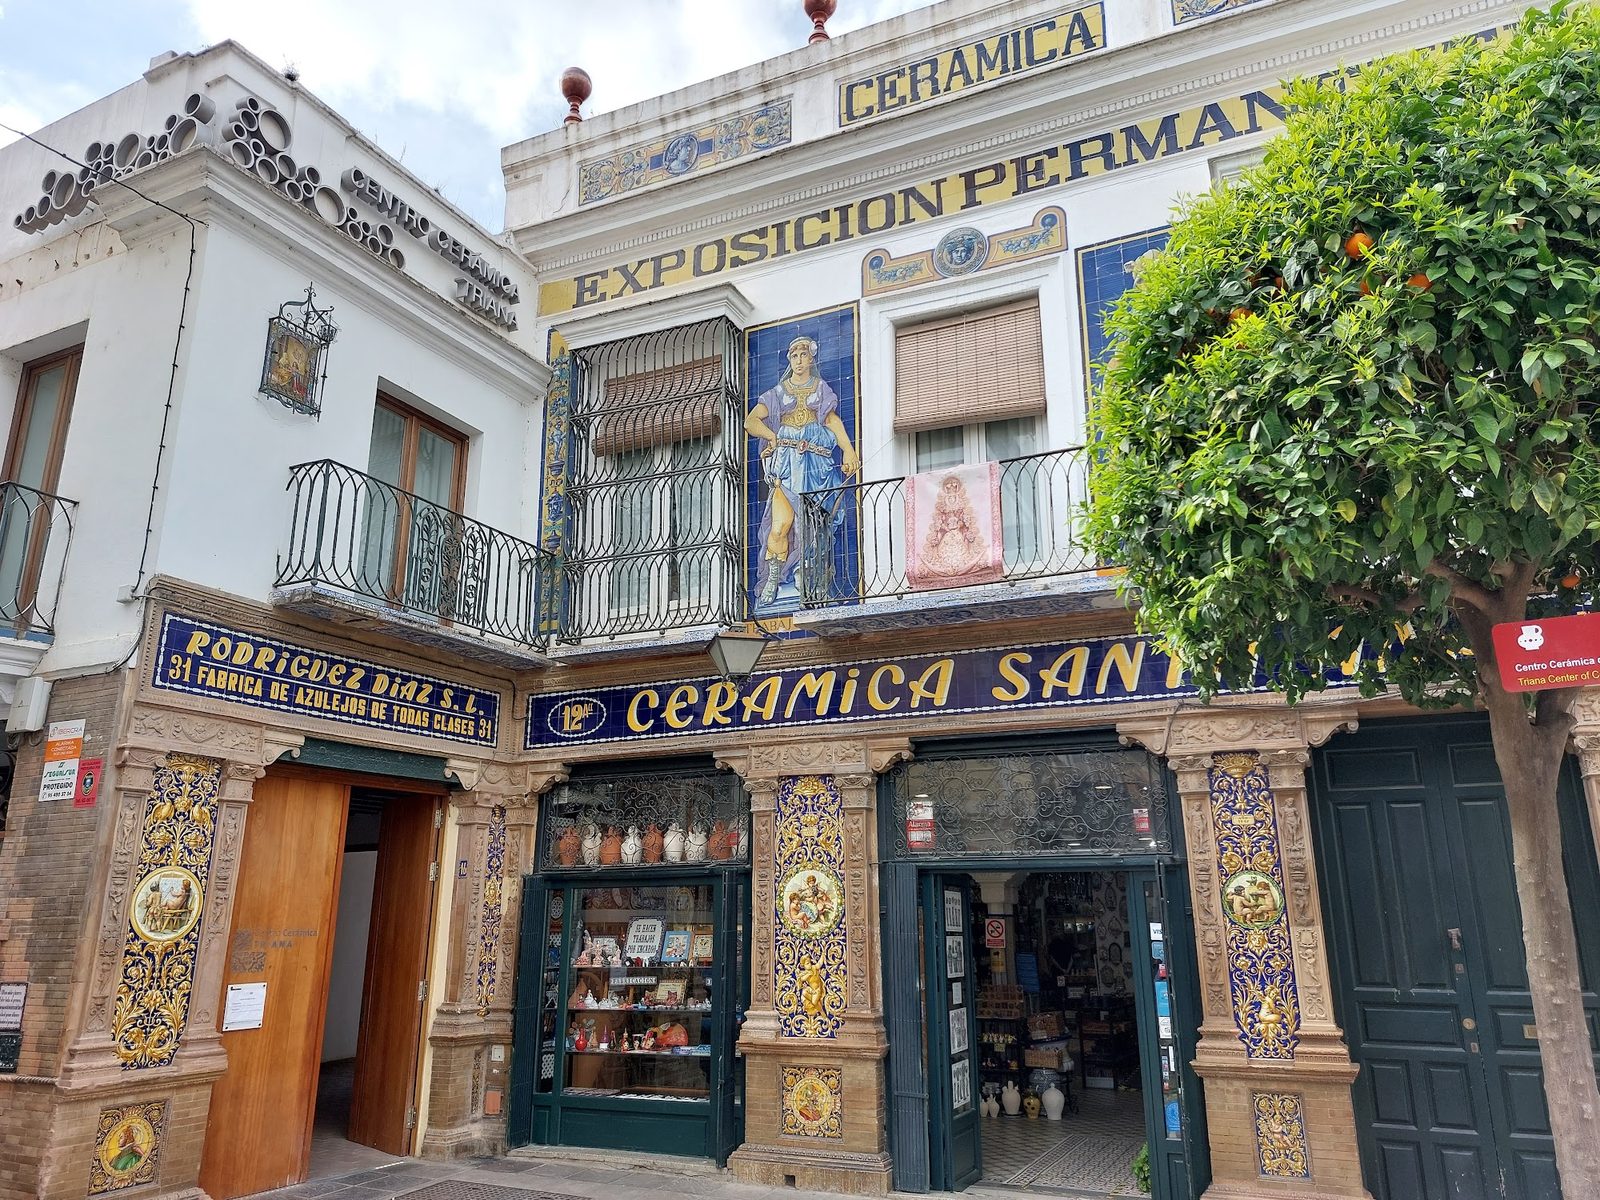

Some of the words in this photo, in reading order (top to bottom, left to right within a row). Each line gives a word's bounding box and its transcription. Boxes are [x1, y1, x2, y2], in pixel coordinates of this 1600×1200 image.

[341, 166, 431, 238] CENTRO
[573, 177, 947, 310] EXPOSICION
[455, 276, 519, 332] TRIANA
[1515, 663, 1548, 673] Centro
[1549, 657, 1596, 669] Cerámica
[1517, 677, 1547, 686] Triana
[1548, 673, 1579, 684] Center
[1581, 671, 1590, 680] of
[168, 654, 192, 683] 31
[197, 665, 262, 697] FABRICA
[270, 681, 290, 702] DE
[295, 686, 366, 717] AZULEJOS
[371, 701, 388, 720] DE
[393, 705, 429, 728] TODAS
[433, 713, 475, 736] CLASES
[478, 717, 493, 739] 31
[440, 688, 459, 711] S.
[51, 745, 77, 753] CONECTADA
[43, 781, 74, 791] PROTEGIDO
